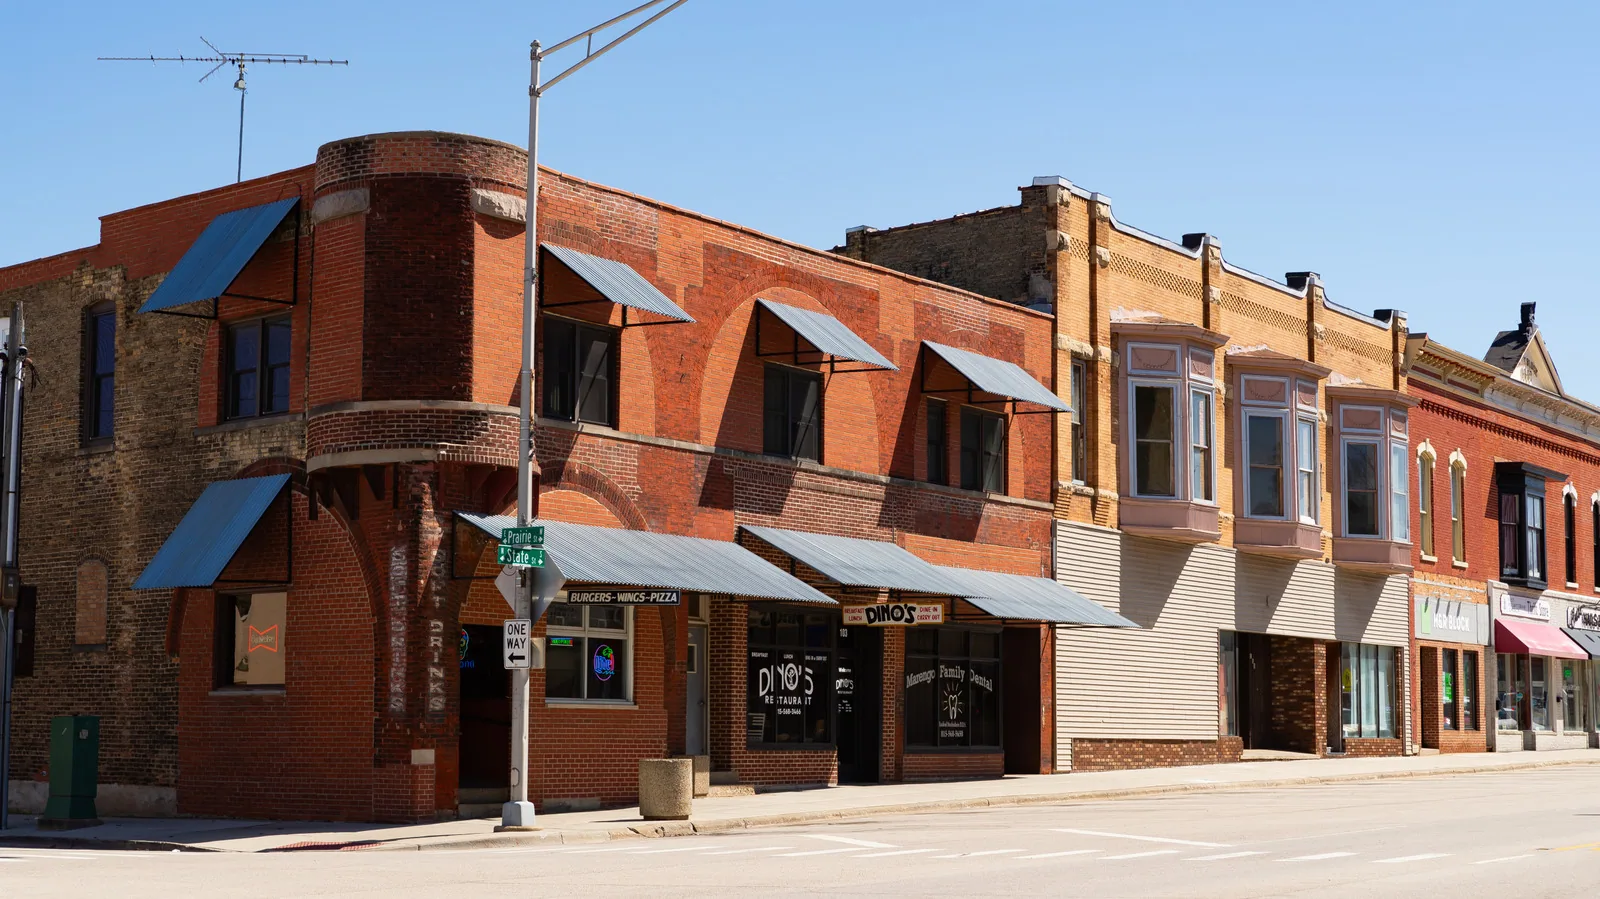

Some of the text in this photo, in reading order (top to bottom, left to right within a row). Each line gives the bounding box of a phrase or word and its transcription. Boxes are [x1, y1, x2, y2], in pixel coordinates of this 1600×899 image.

[507, 530, 532, 544] Prairie
[507, 548, 529, 563] State
[864, 603, 917, 624] DINO'S
[507, 623, 527, 635] ONE
[1433, 613, 1470, 632] H&R BLOCK
[506, 637, 527, 649] WAY
[428, 619, 445, 711] DRINKS
[906, 664, 993, 692] Marengo Family Dental
